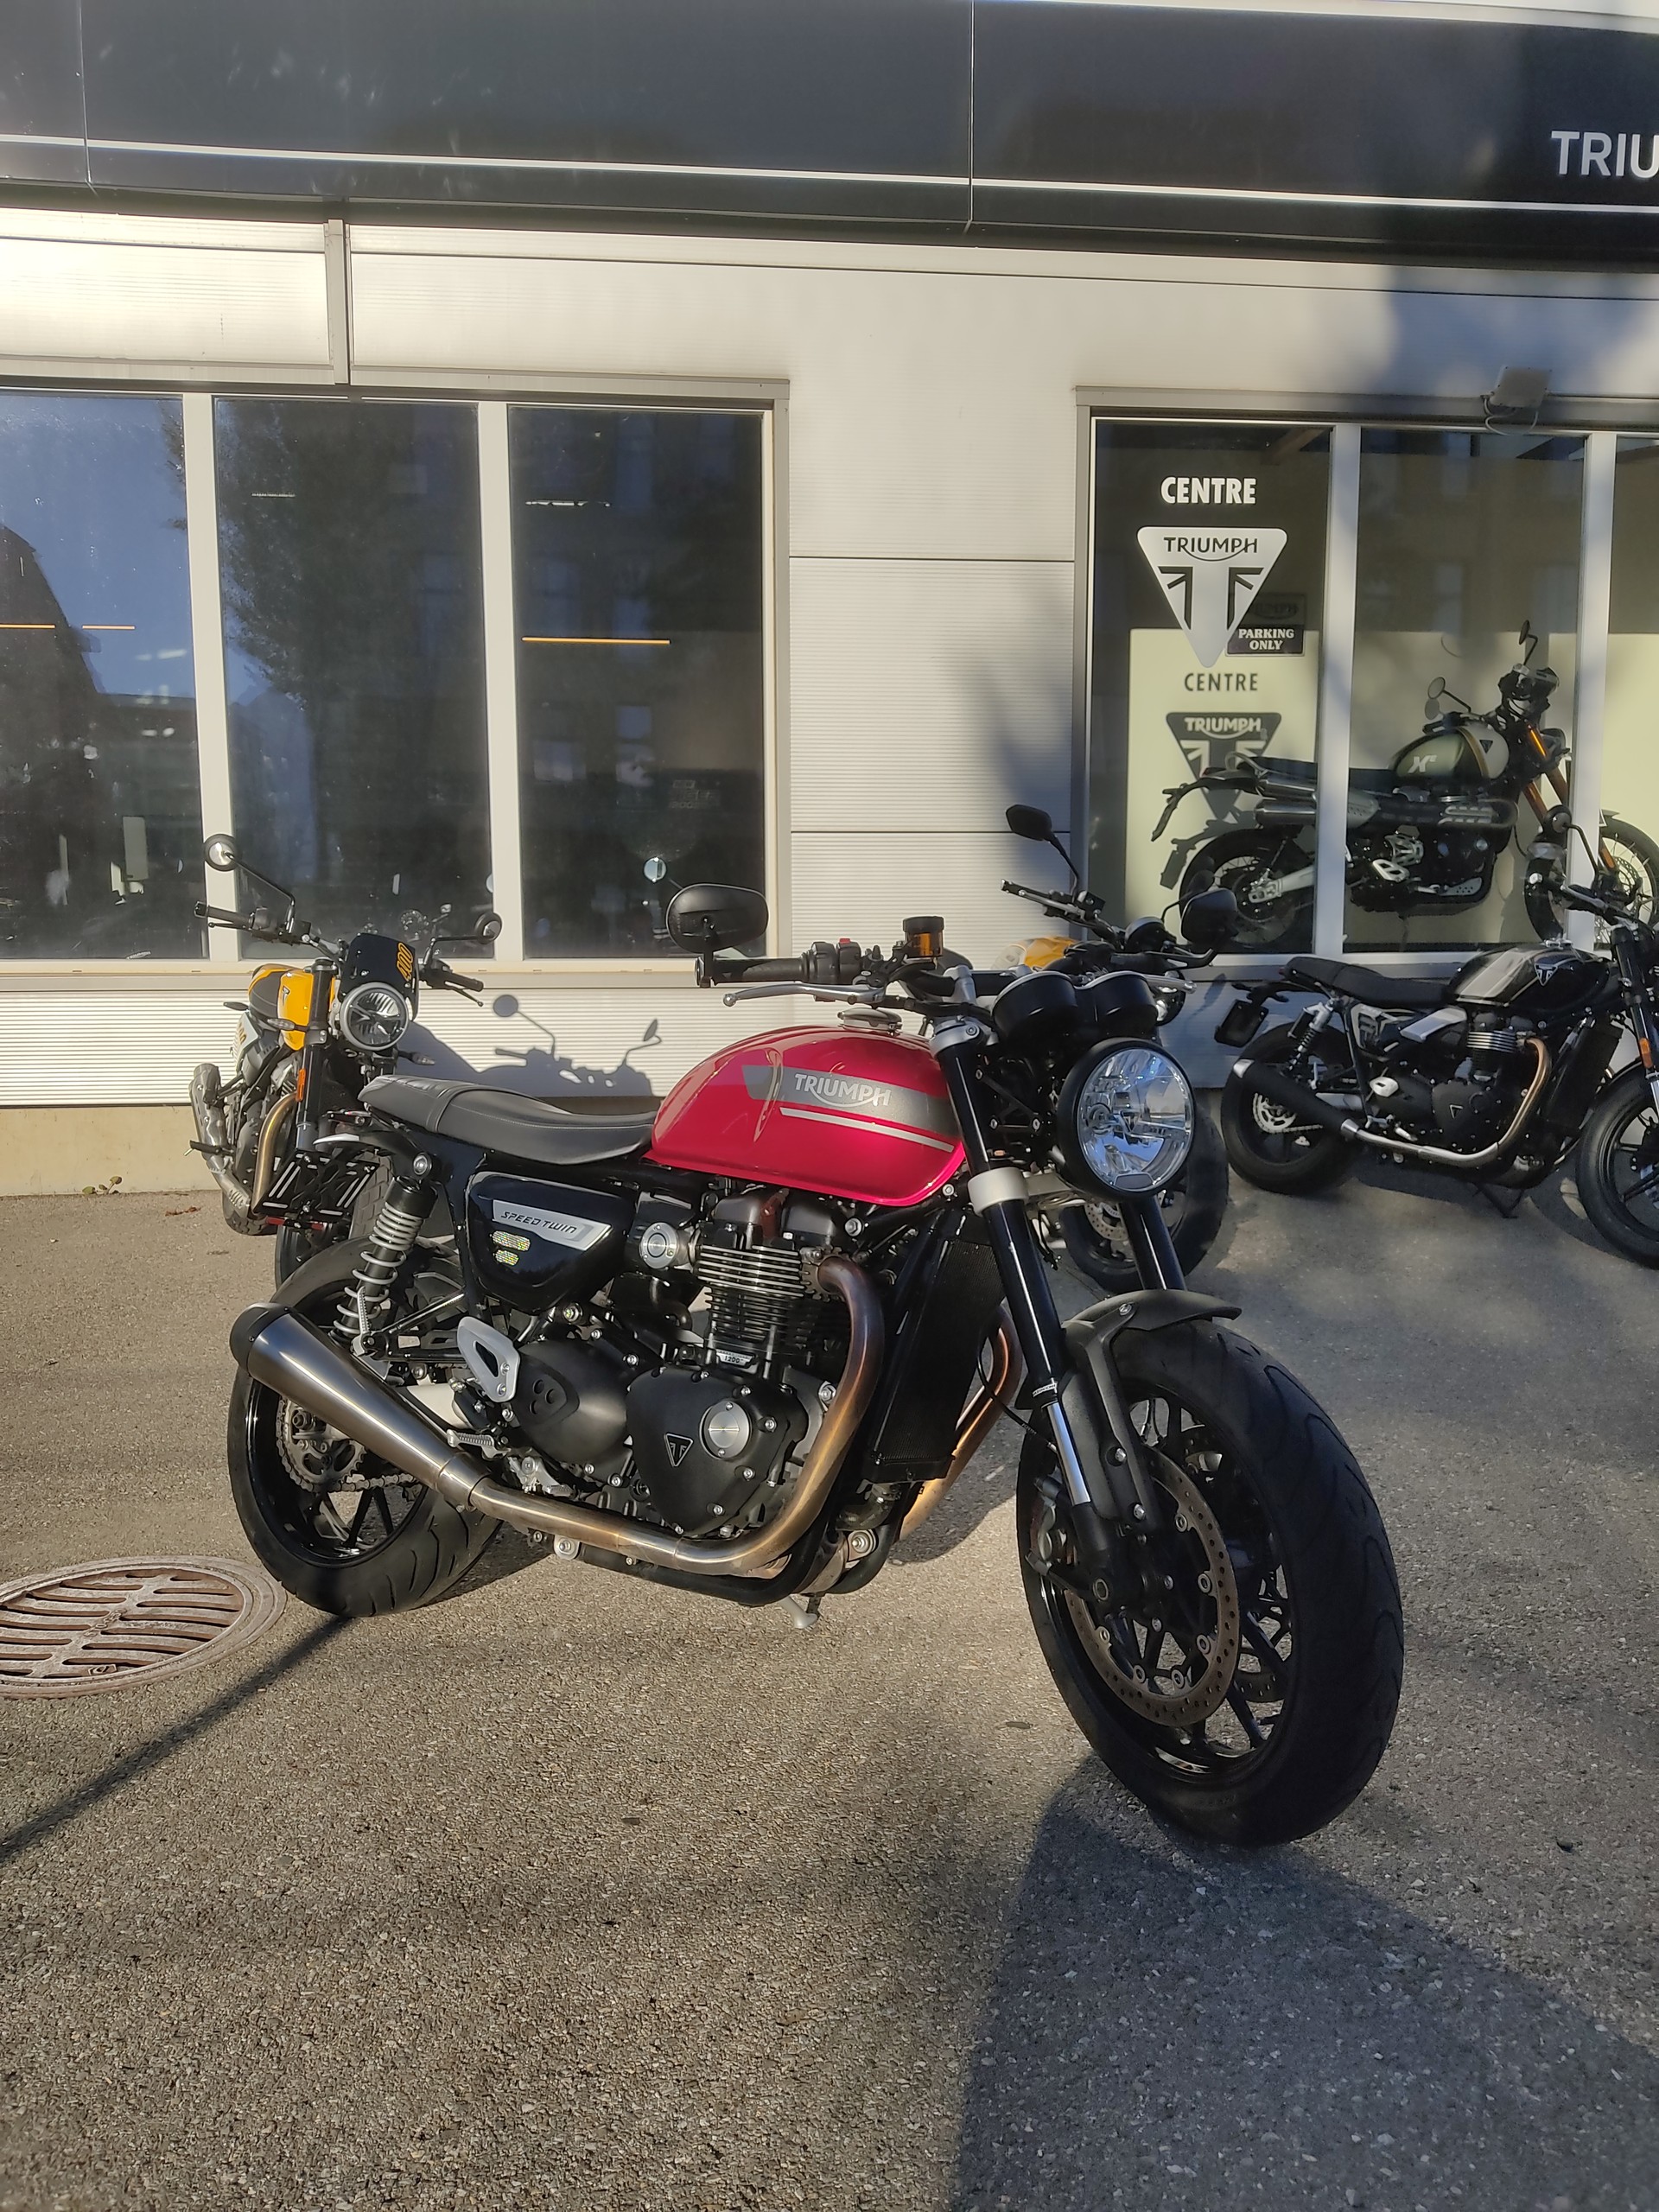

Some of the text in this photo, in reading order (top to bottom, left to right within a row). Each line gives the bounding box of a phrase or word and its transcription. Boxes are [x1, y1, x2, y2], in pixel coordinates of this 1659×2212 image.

[1551, 130, 1659, 178] TRIU
[1160, 476, 1257, 504] CENTRE
[1163, 537, 1258, 562] TRIUMPH
[1238, 628, 1295, 639] PARKING
[1249, 639, 1284, 651] ONLY
[1184, 672, 1258, 691] CENTRE
[1184, 717, 1262, 739] TRIUMPH
[794, 1072, 893, 1108] TRIUMPH
[500, 1211, 577, 1234] SPEED TWIN
